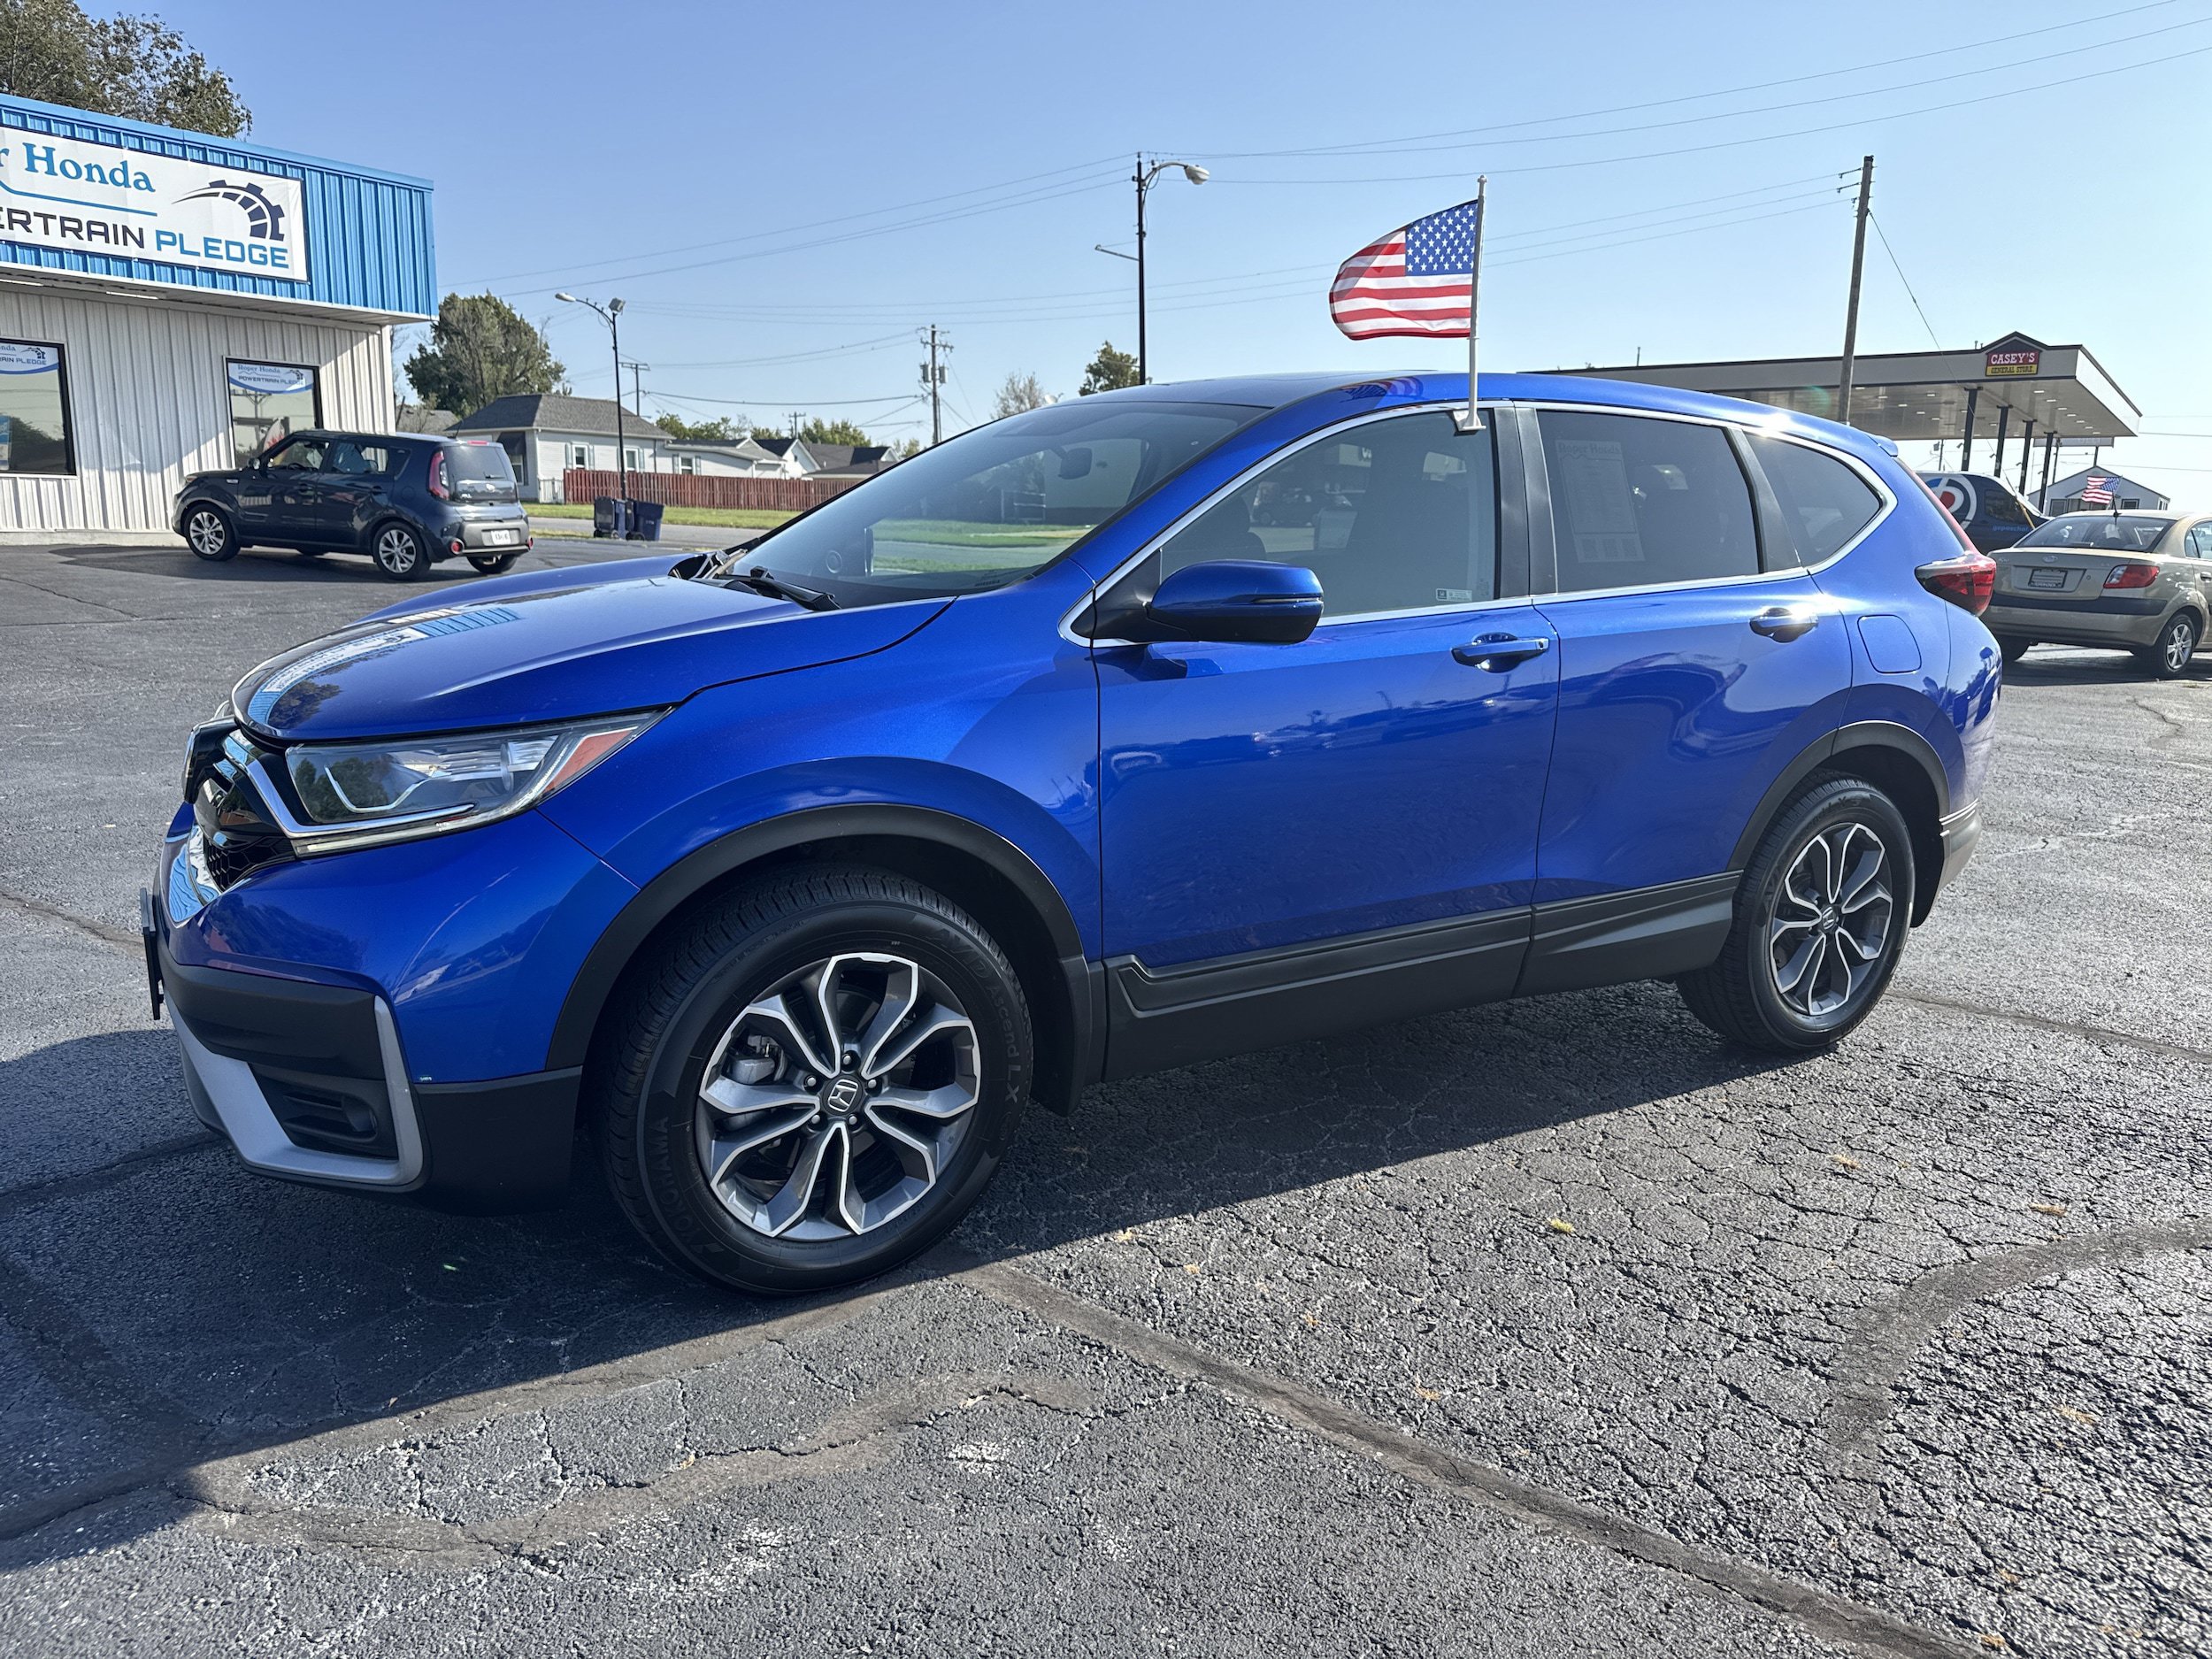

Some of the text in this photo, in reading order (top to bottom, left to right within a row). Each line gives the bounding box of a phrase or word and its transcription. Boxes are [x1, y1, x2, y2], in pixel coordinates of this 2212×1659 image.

[22, 142, 156, 193] Honda
[155, 229, 289, 269] PLEDGE
[238, 375, 280, 384] POWERTRAIN
[1991, 352, 2035, 365] CASEY'S
[986, 983, 1020, 1059] Ascend
[1005, 1064, 1022, 1104] LX
[648, 1116, 701, 1242] YOKOHAMA
